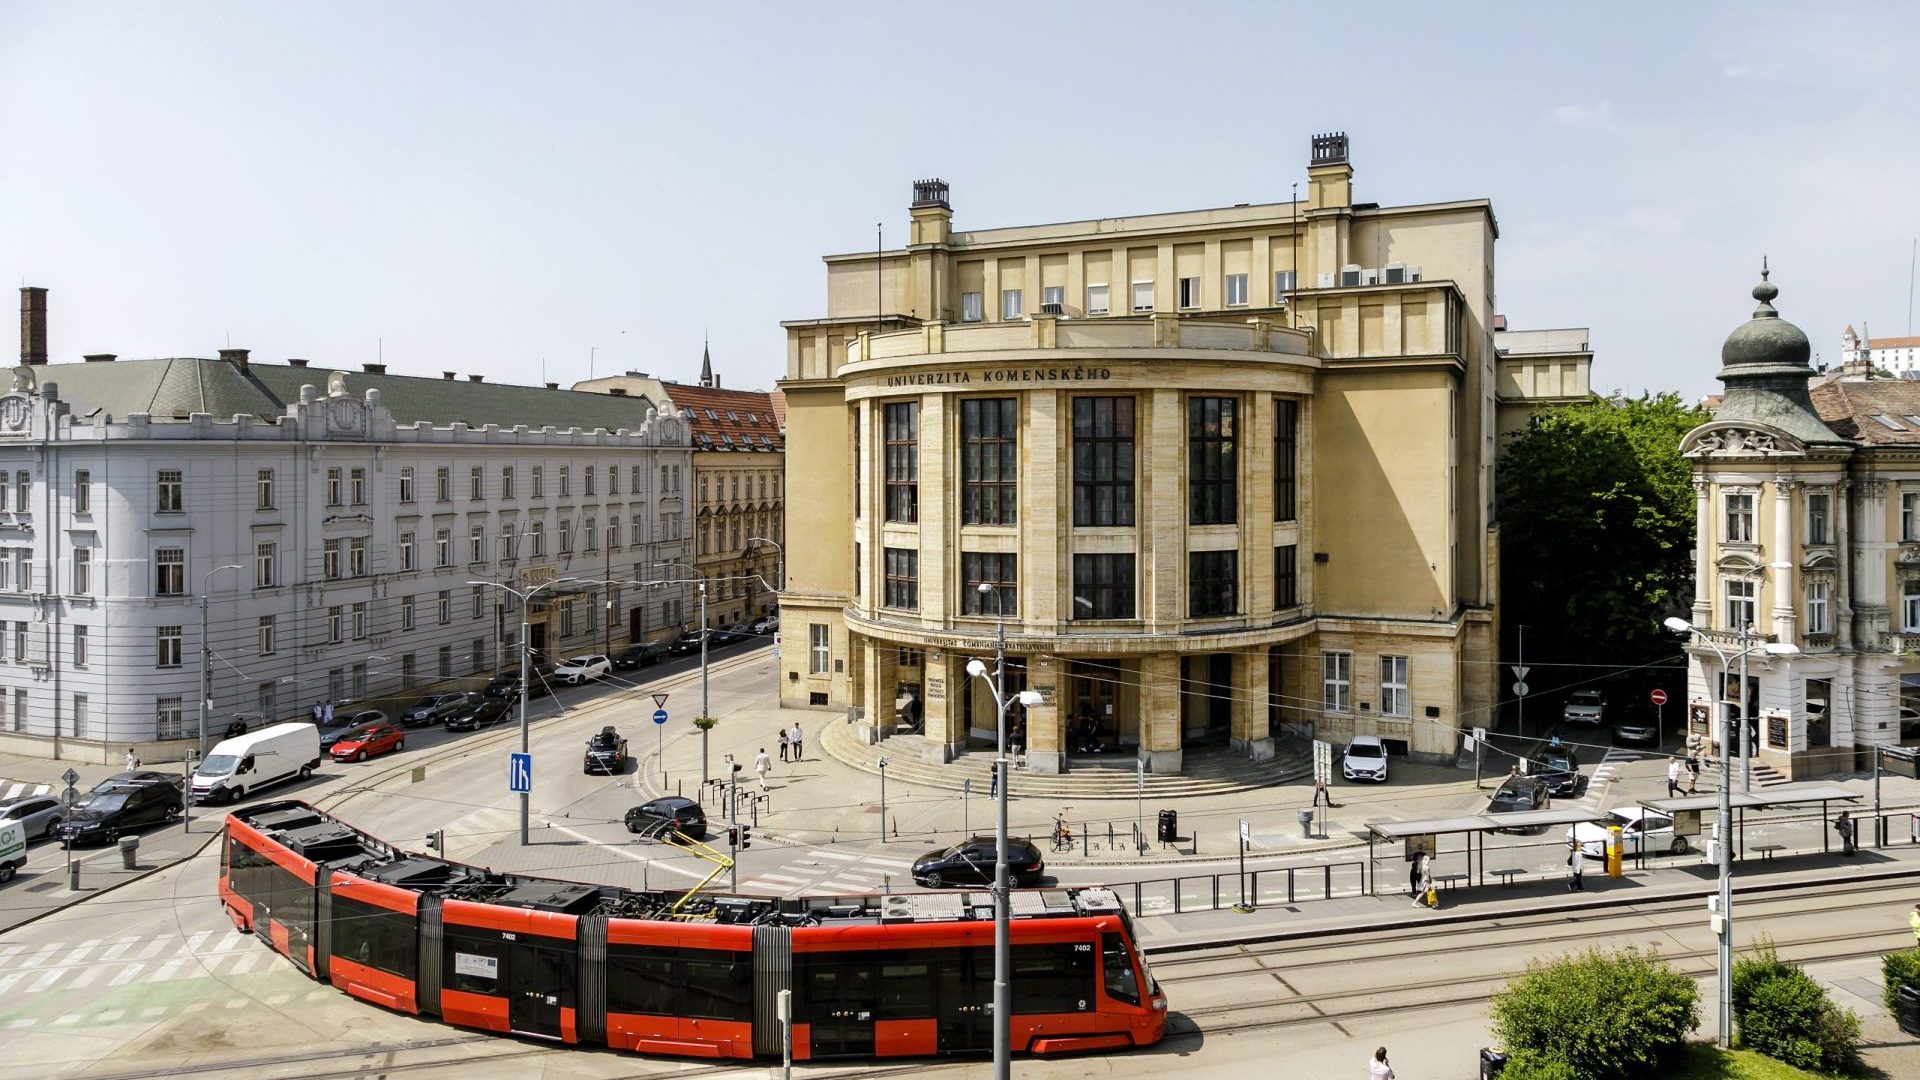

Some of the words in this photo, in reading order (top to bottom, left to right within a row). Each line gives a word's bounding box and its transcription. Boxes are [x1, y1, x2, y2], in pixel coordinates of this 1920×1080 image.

[888, 372, 970, 387] UNIVERZITA
[984, 366, 1111, 382] KOMENSKÉHO
[963, 639, 999, 650] COMENIAN
[501, 932, 516, 940] 7402
[1074, 944, 1091, 952] 7402
